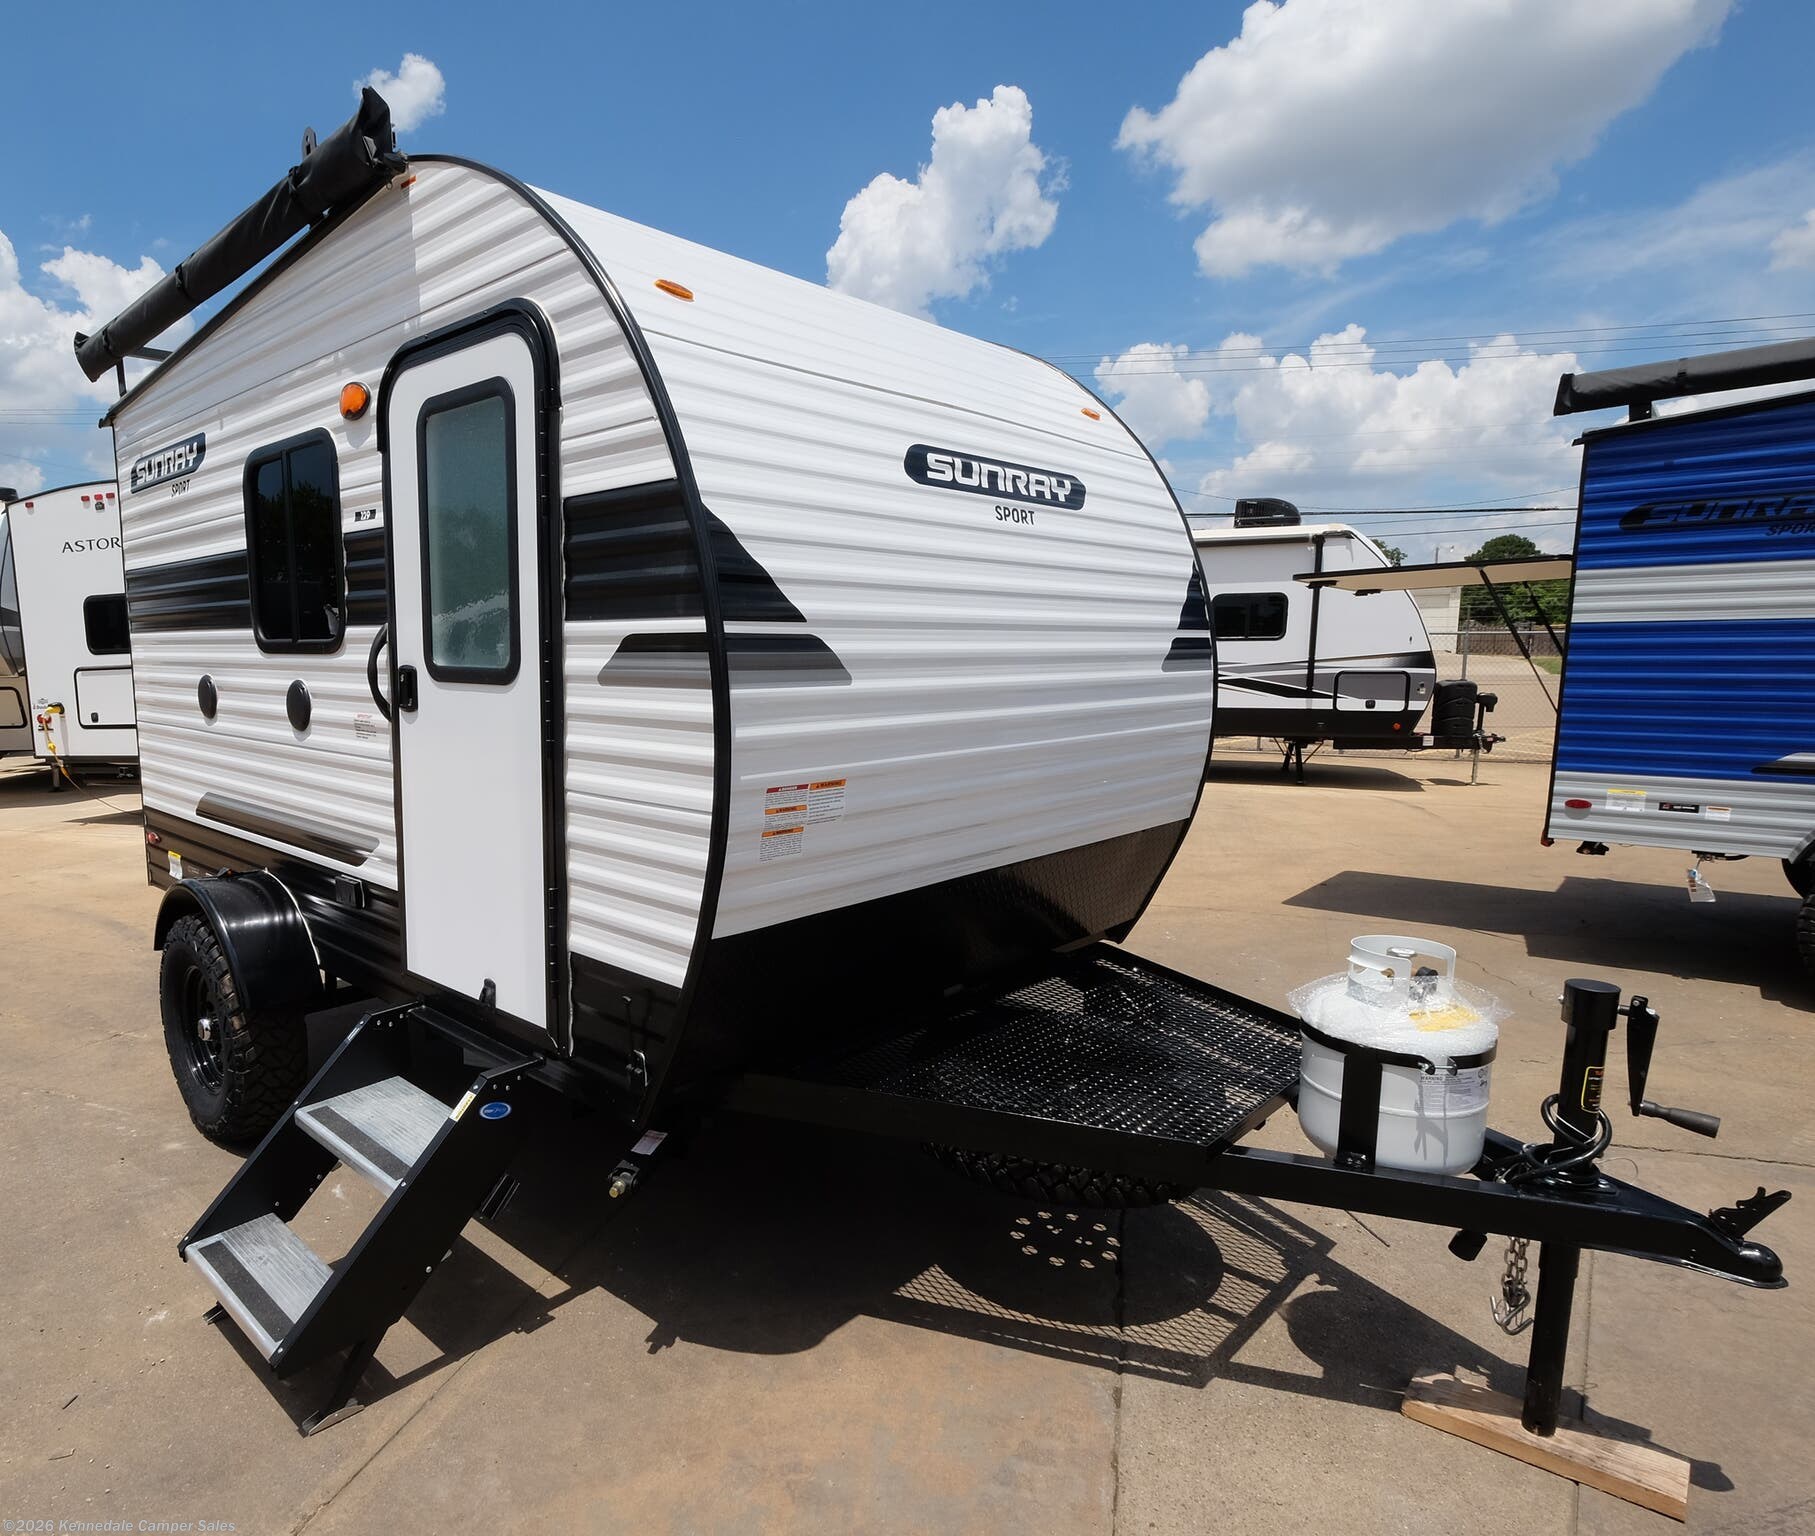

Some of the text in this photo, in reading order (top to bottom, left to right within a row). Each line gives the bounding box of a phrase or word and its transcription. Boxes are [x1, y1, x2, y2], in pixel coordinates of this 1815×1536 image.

[136, 442, 198, 486] SUNRAY
[926, 452, 1072, 502] SUNRAY
[994, 505, 1035, 526] SPORT
[62, 536, 122, 553] ASTOR
